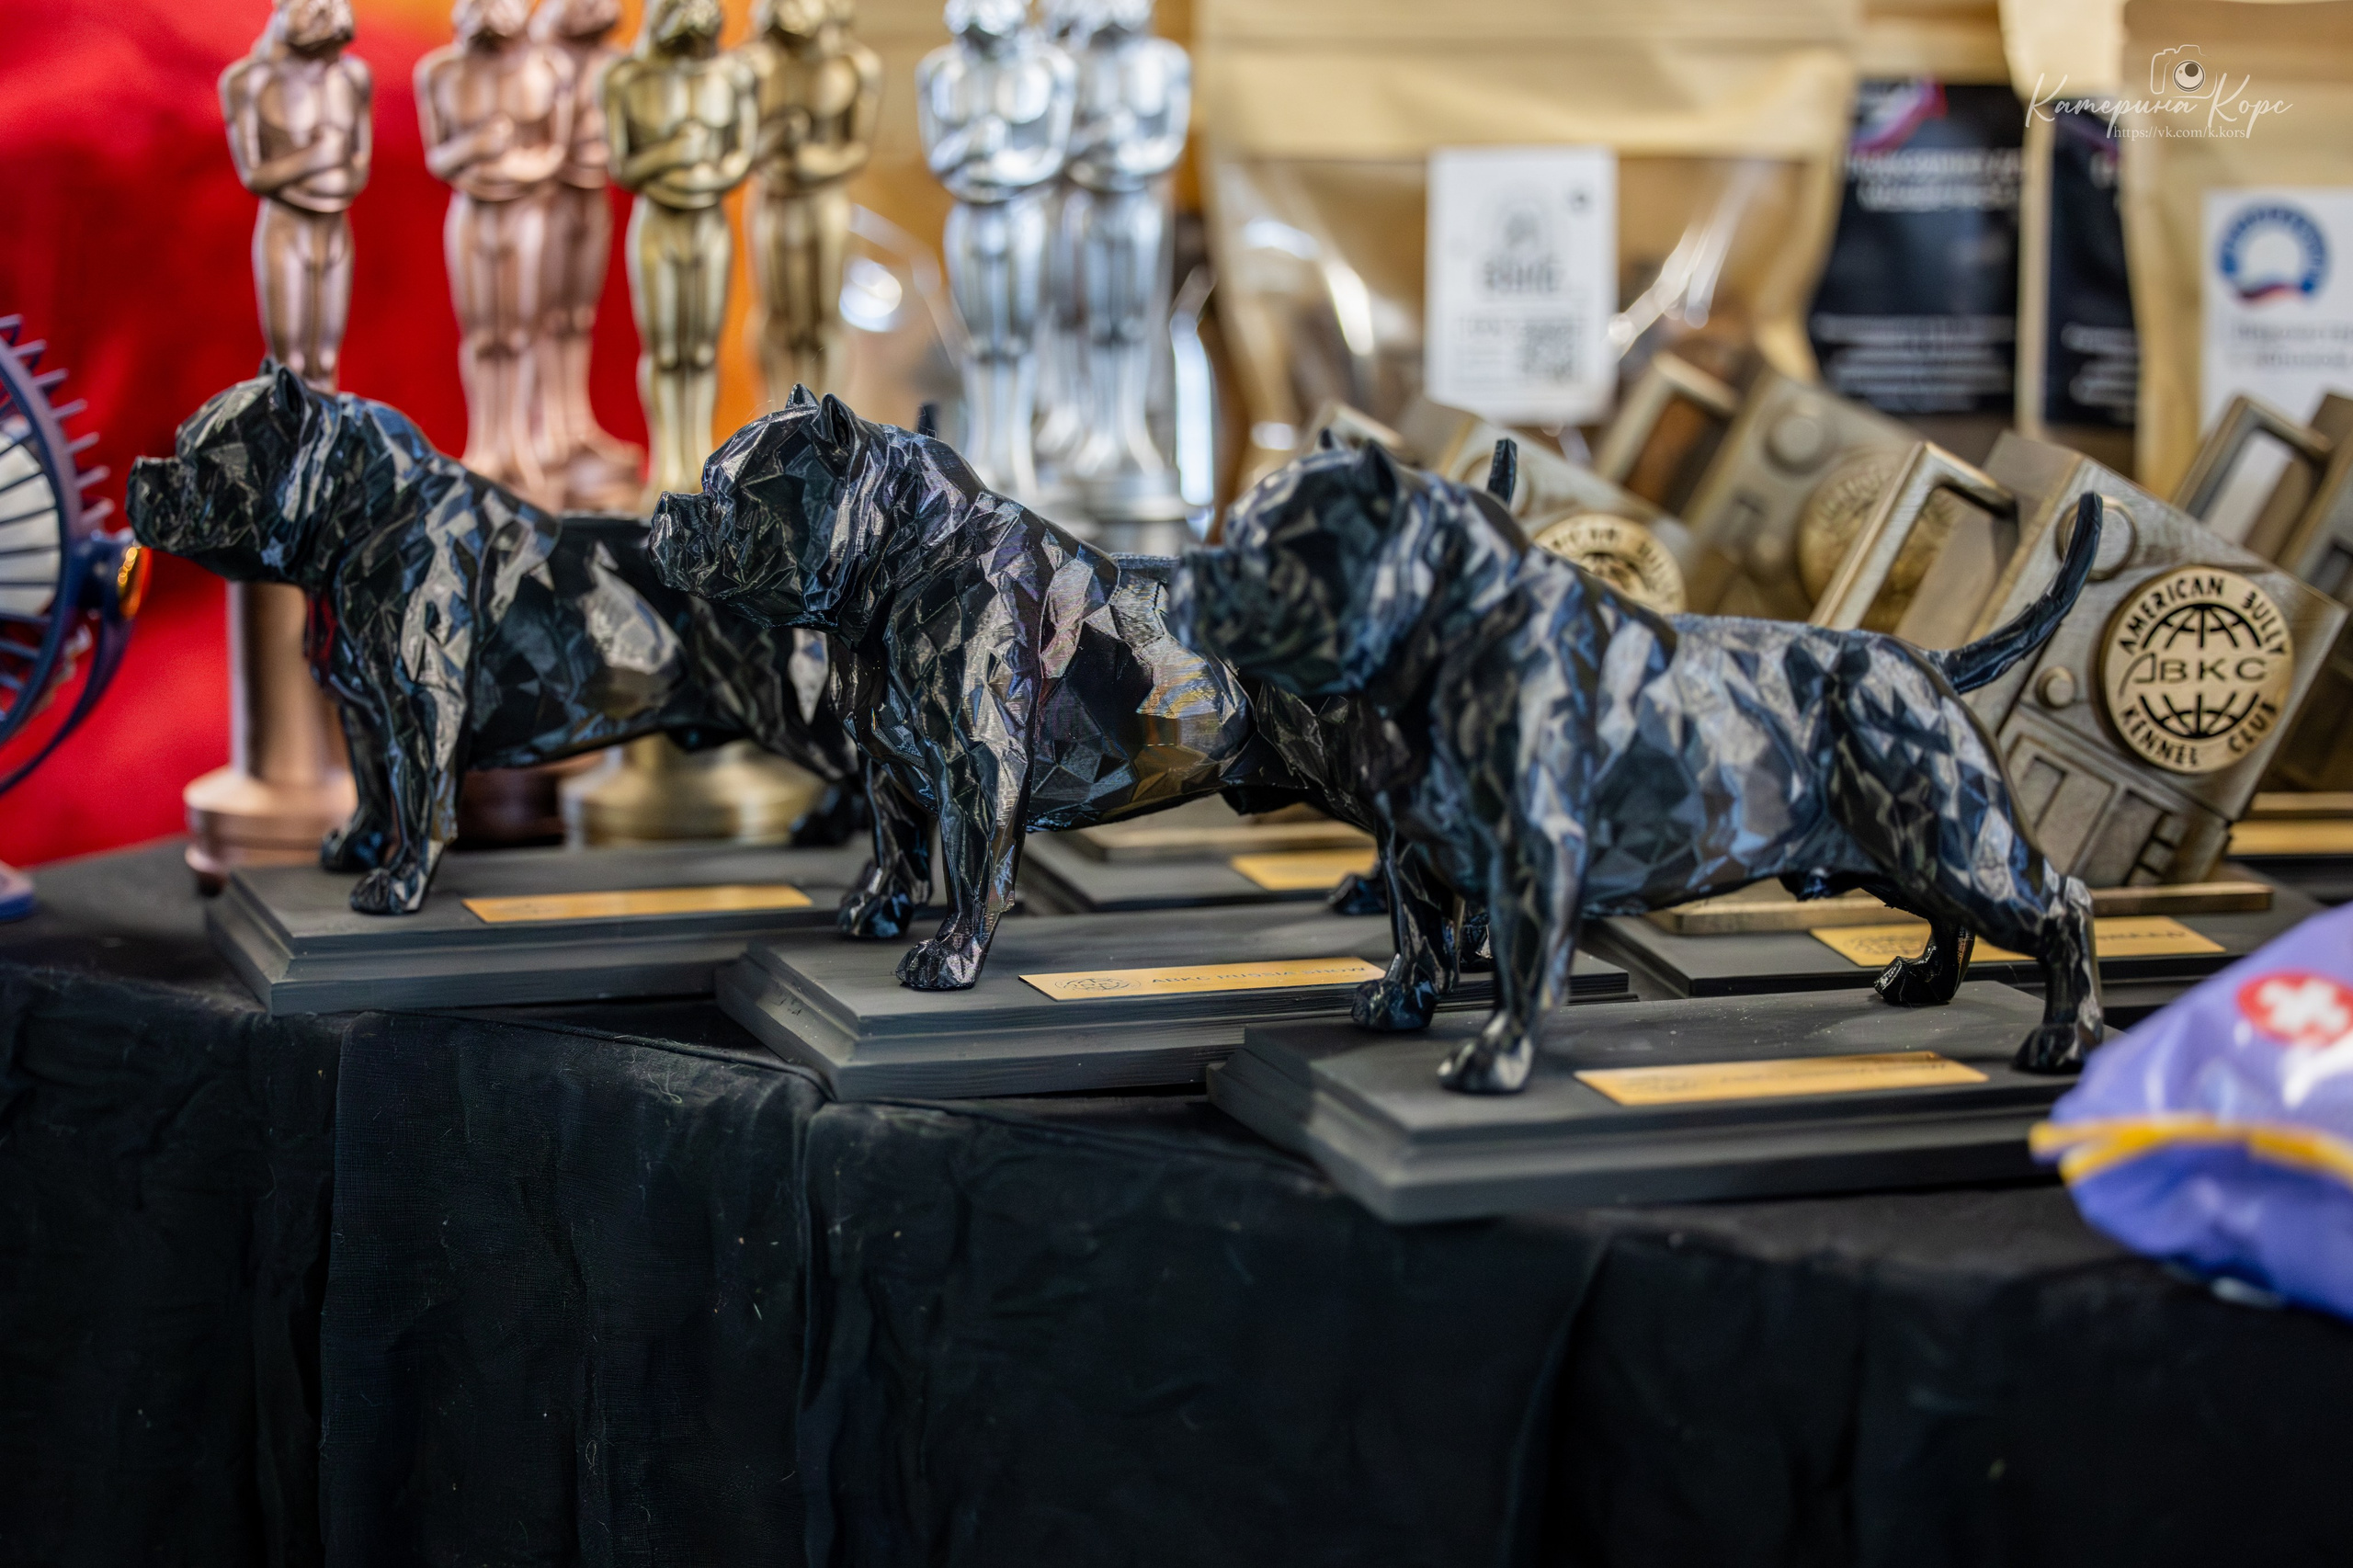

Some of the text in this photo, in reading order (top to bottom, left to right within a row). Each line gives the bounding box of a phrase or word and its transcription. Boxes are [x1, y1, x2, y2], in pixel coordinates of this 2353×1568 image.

[2120, 576, 2286, 654] AMERICAN BULLY
[2119, 652, 2267, 699] ABKC
[2121, 702, 2277, 766] KENNEL CLUB
